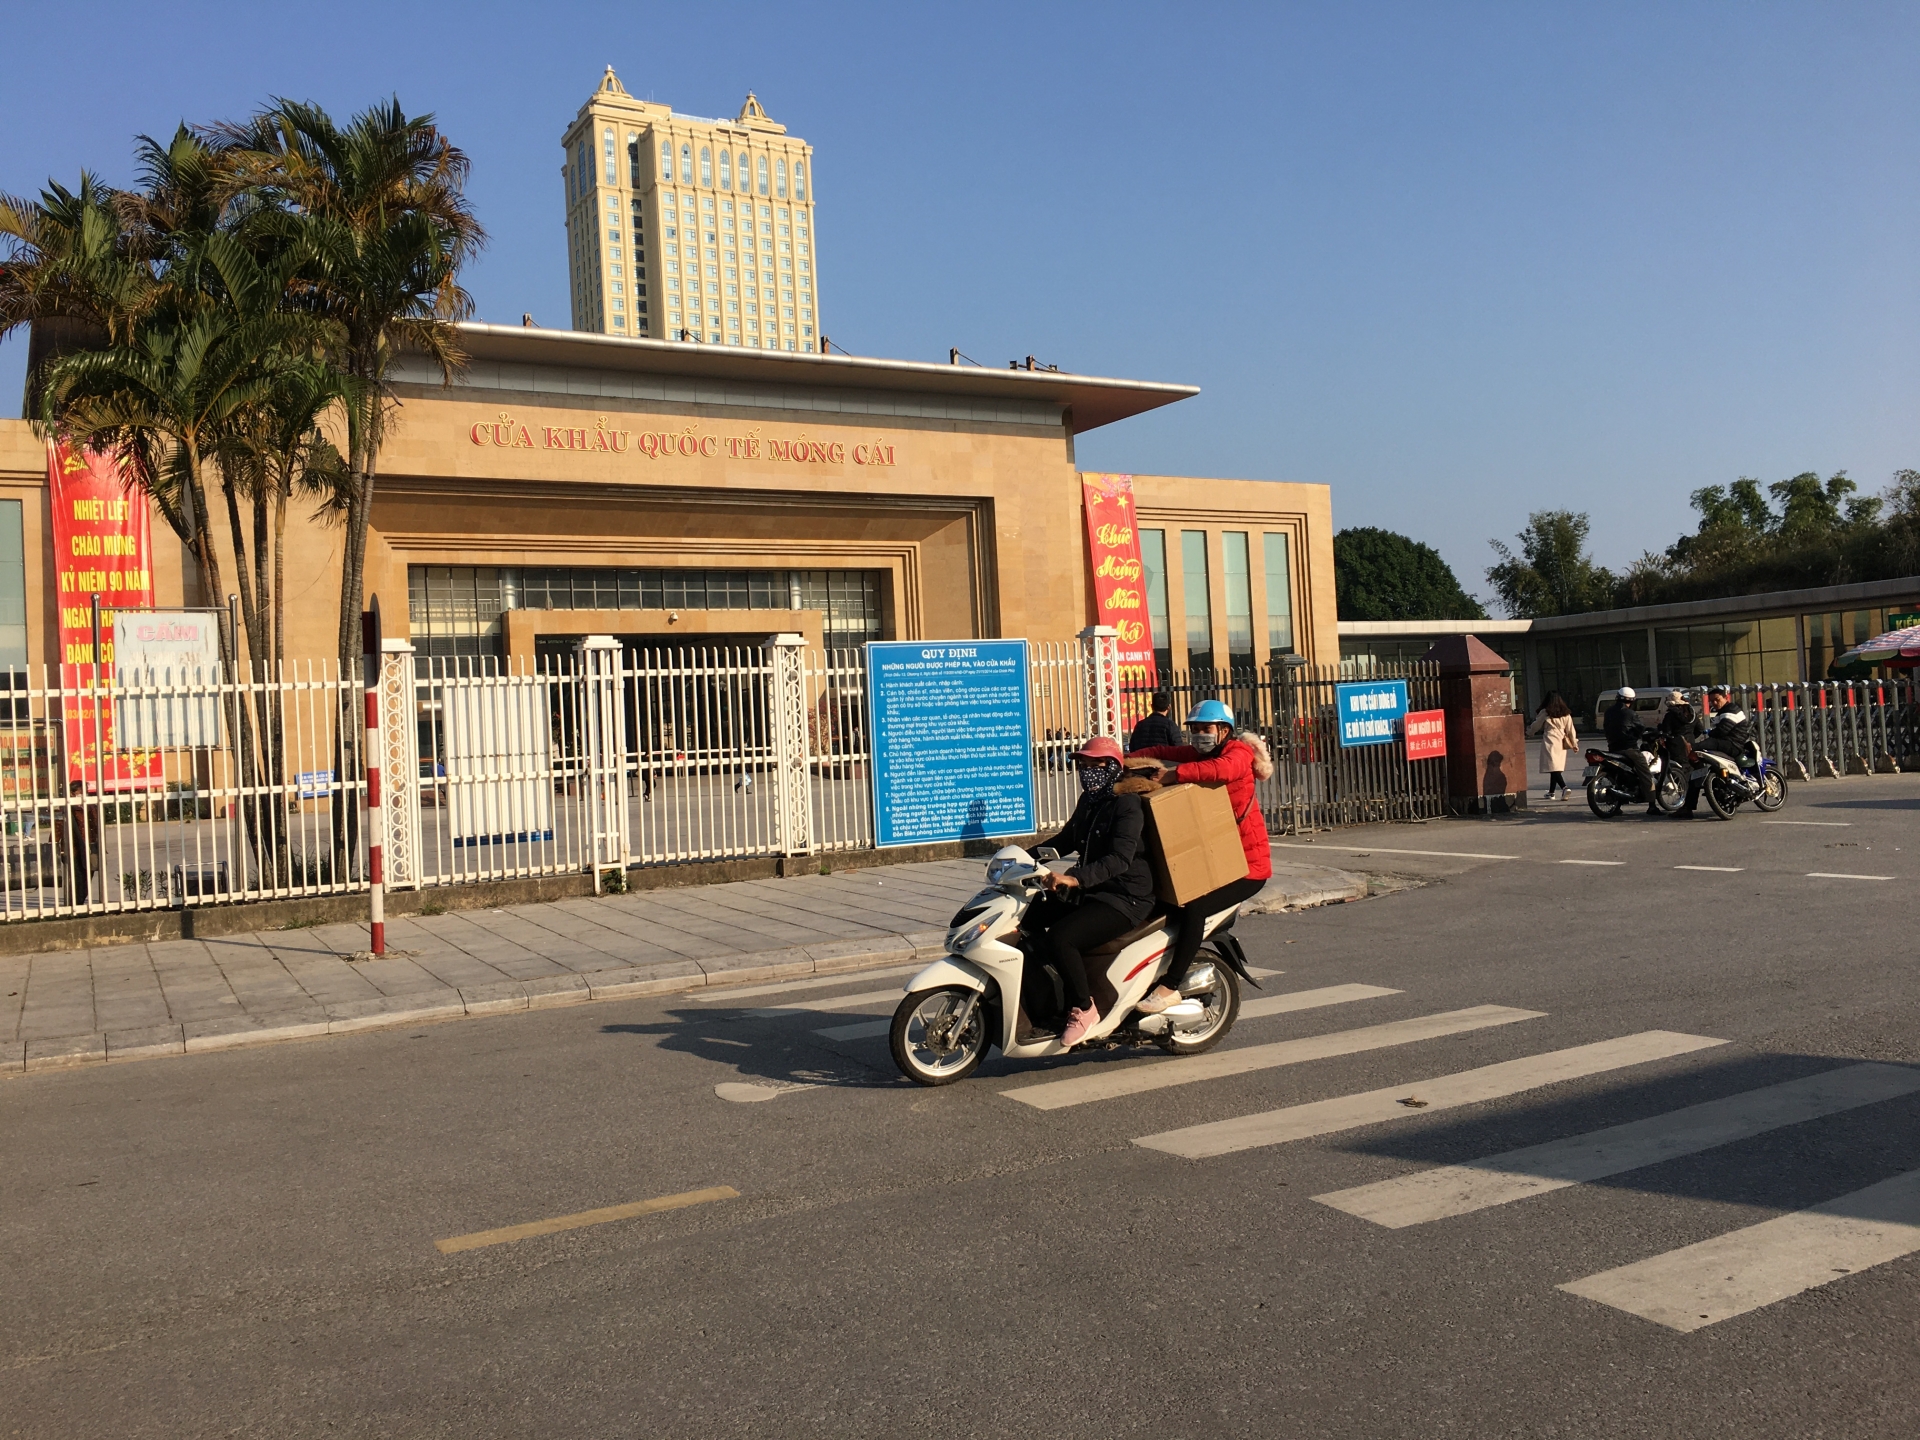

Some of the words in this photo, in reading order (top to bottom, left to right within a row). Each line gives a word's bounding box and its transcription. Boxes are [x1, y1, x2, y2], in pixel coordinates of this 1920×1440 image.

[469, 411, 534, 449] CỬA
[542, 415, 630, 454] KHẨU
[637, 423, 718, 459] QUỐC
[725, 427, 762, 460] TẾ
[769, 432, 846, 465] MÓNG
[852, 437, 898, 467] CÁI
[73, 496, 105, 525] NHIỆT
[107, 496, 129, 526] LIỆT
[71, 531, 101, 557] CHÀO
[103, 531, 137, 556] MỪNG
[1096, 523, 1132, 548] Chúc
[61, 564, 75, 593] KỶ
[109, 570, 123, 592] 90
[125, 566, 150, 591] NĂM
[1096, 554, 1141, 582] Mừng
[1104, 587, 1141, 610] Năm
[137, 621, 199, 641] CẤM
[921, 649, 945, 659] QUY
[948, 648, 977, 660] ĐỊNH
[1125, 651, 1143, 661] CANH
[1118, 664, 1147, 682] 2020
